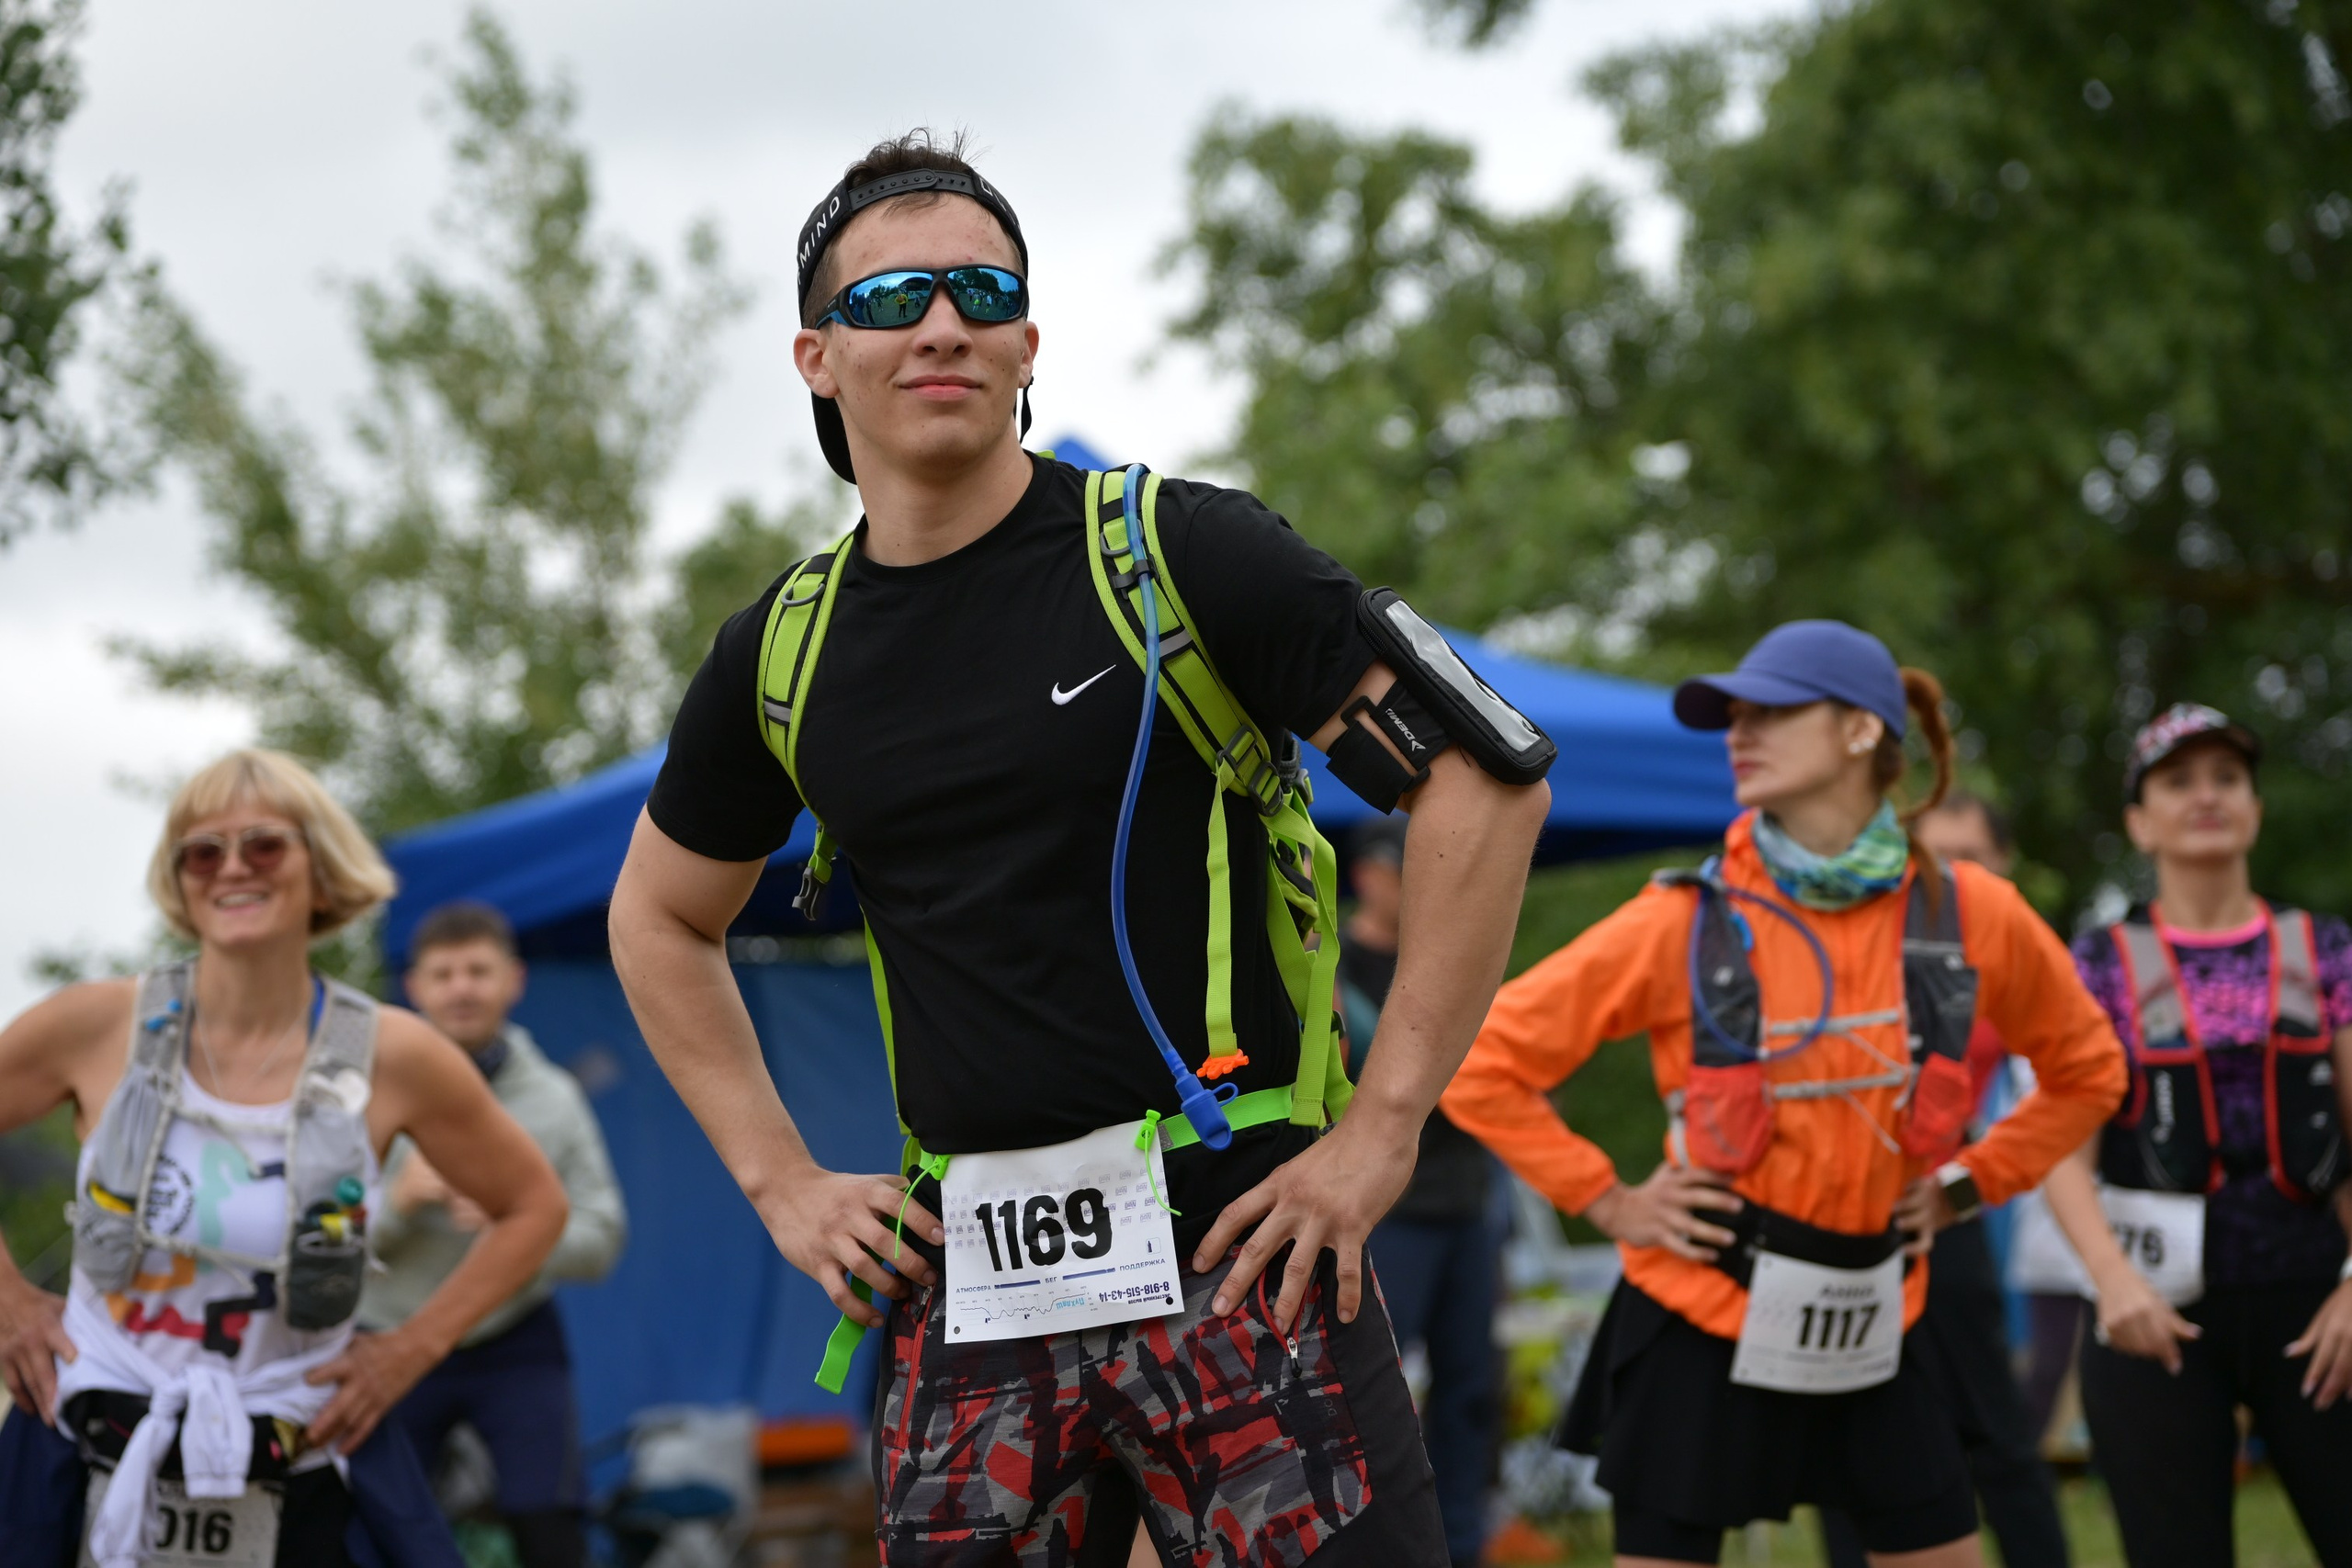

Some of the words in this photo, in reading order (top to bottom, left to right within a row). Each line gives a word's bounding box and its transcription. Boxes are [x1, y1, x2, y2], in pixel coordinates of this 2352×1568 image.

[976, 1187, 1113, 1272] 1169
[956, 1284, 992, 1294] АТМОСФЕРА
[1045, 1276, 1057, 1285] БЕГ
[1119, 1258, 1166, 1272] ПОДДЕРЖКА
[1098, 1280, 1170, 1303] 8-918-515-43-14
[1798, 1302, 1881, 1350] 1117
